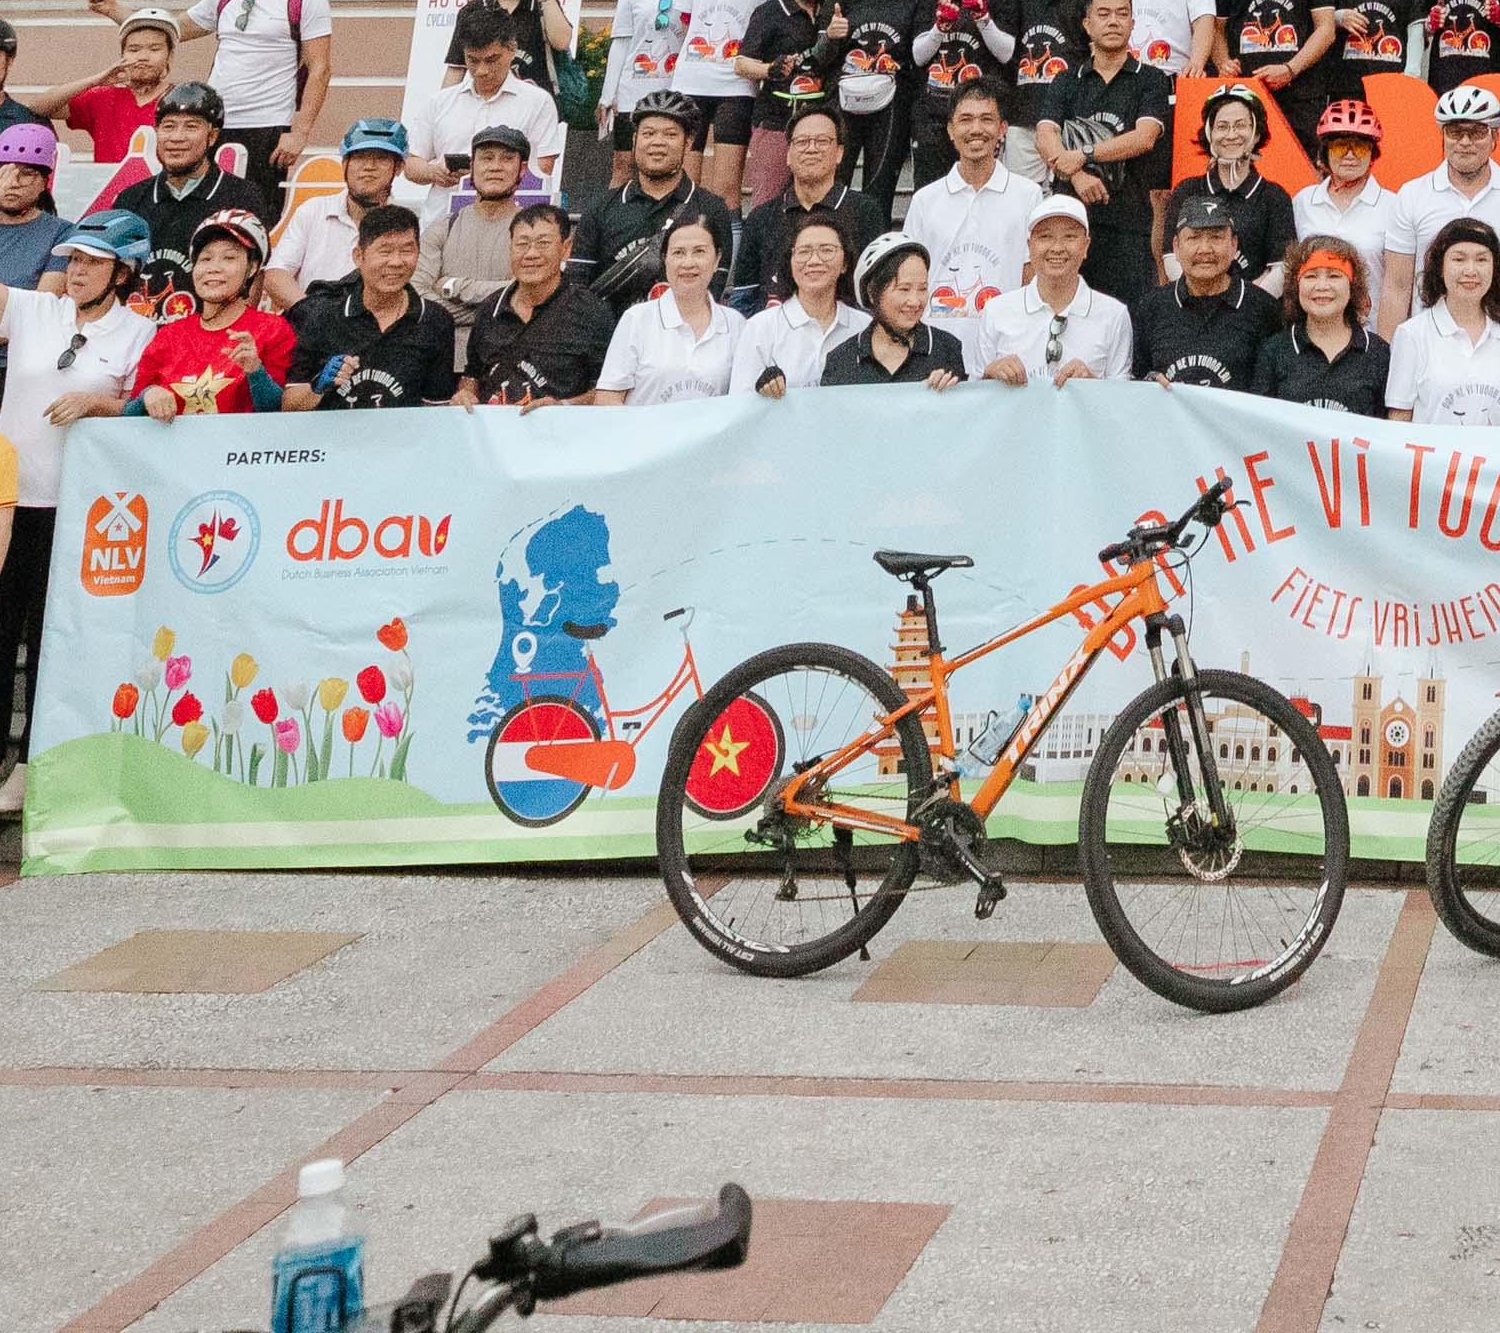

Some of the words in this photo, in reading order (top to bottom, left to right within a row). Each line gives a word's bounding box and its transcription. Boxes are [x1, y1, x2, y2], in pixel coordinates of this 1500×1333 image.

[226, 448, 326, 466] PARTNERS:
[89, 546, 143, 572] NLV
[93, 574, 136, 585] Vietnam
[281, 568, 312, 581] Dutch
[313, 567, 352, 579] Business
[353, 566, 408, 579] Association
[410, 564, 449, 576] Vietnam
[1271, 566, 1363, 640] FIETS
